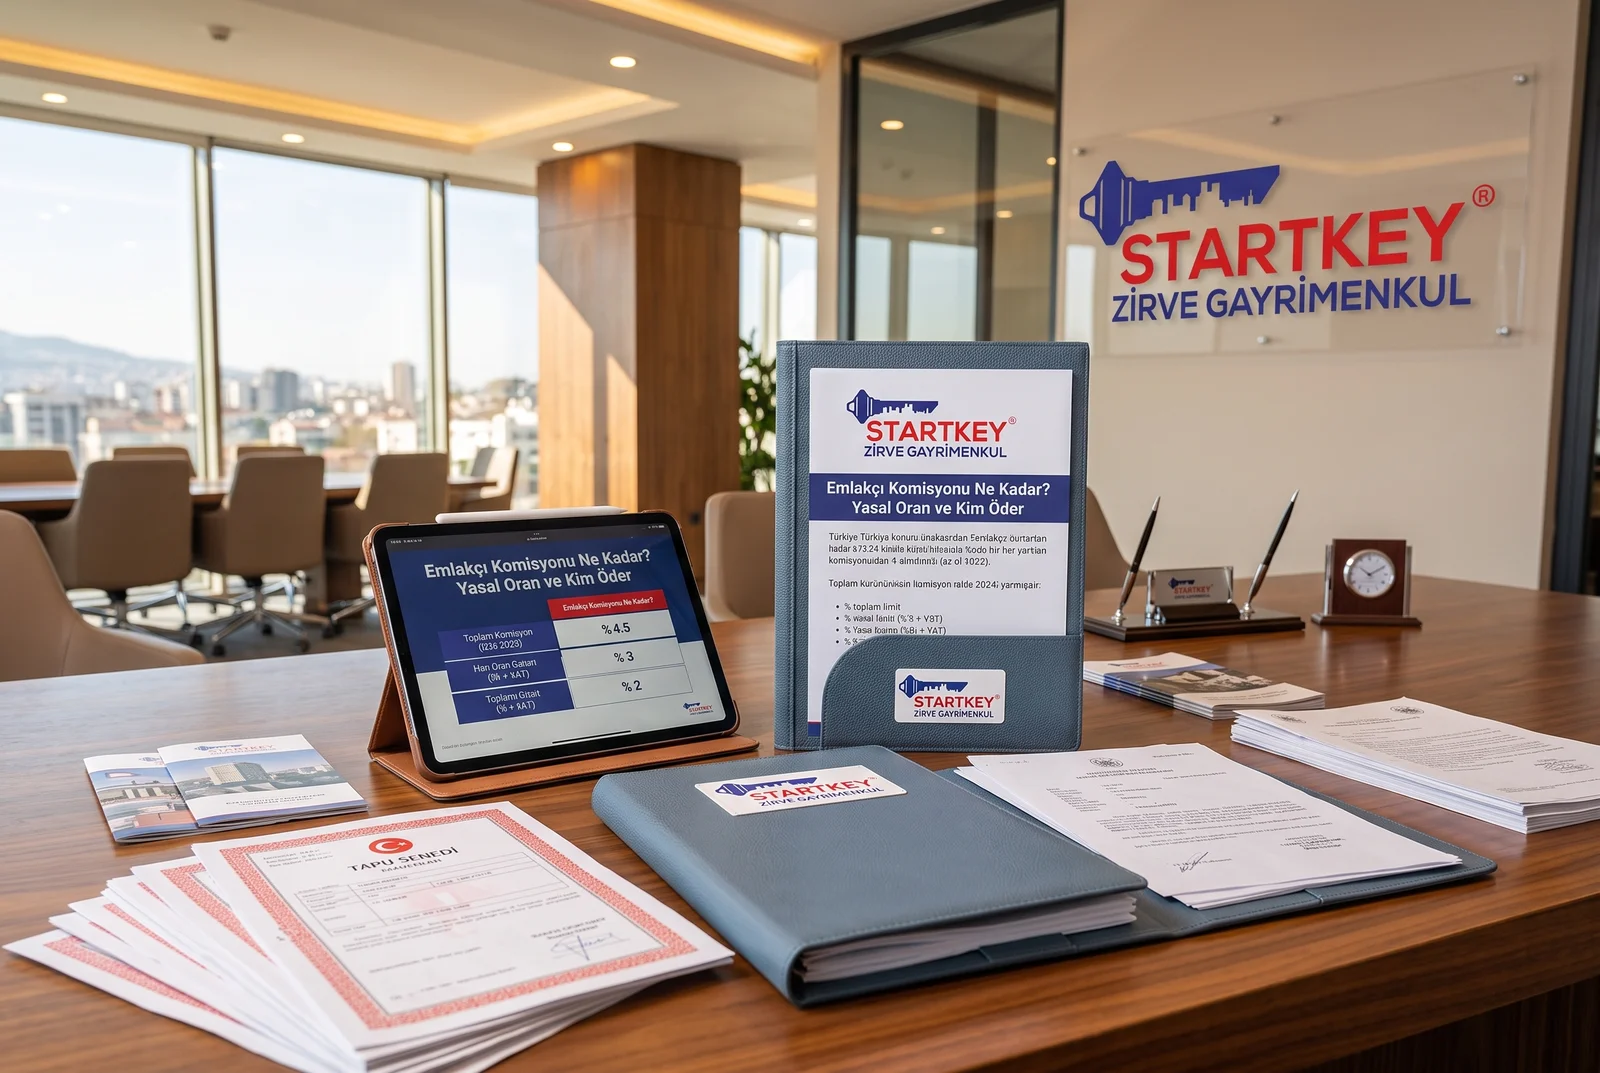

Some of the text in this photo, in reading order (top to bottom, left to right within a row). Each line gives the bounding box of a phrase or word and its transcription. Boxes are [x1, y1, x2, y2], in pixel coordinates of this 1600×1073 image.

[1120, 201, 1465, 285] STARTKEY
[1111, 273, 1471, 323] ZİRVE GAYRİMENKUL
[866, 420, 1007, 442] STARTKEY
[864, 443, 1007, 458] ZİRVE GAYRİMENKUL
[827, 481, 1050, 498] Emlakçı Komisyonu Ne Kadar?
[852, 498, 1024, 515] Yasal Oran ve Kim Öder
[829, 532, 858, 542] Türkiye
[424, 549, 650, 578] Emlakçı Komisyonu Ne Kadar?
[456, 568, 632, 595] Yasal Oran ve Kim Öder
[829, 579, 858, 589] Toplam
[623, 598, 632, 606] Ne
[853, 603, 881, 612] toplam
[883, 602, 901, 611] limit
[463, 629, 533, 642] Toplam Komisyon
[914, 696, 994, 708] STARTKEY
[914, 709, 994, 718] ZİRVE GAYRİMENKUL
[750, 779, 872, 800] STARTKEY
[347, 859, 394, 872] TAPU
